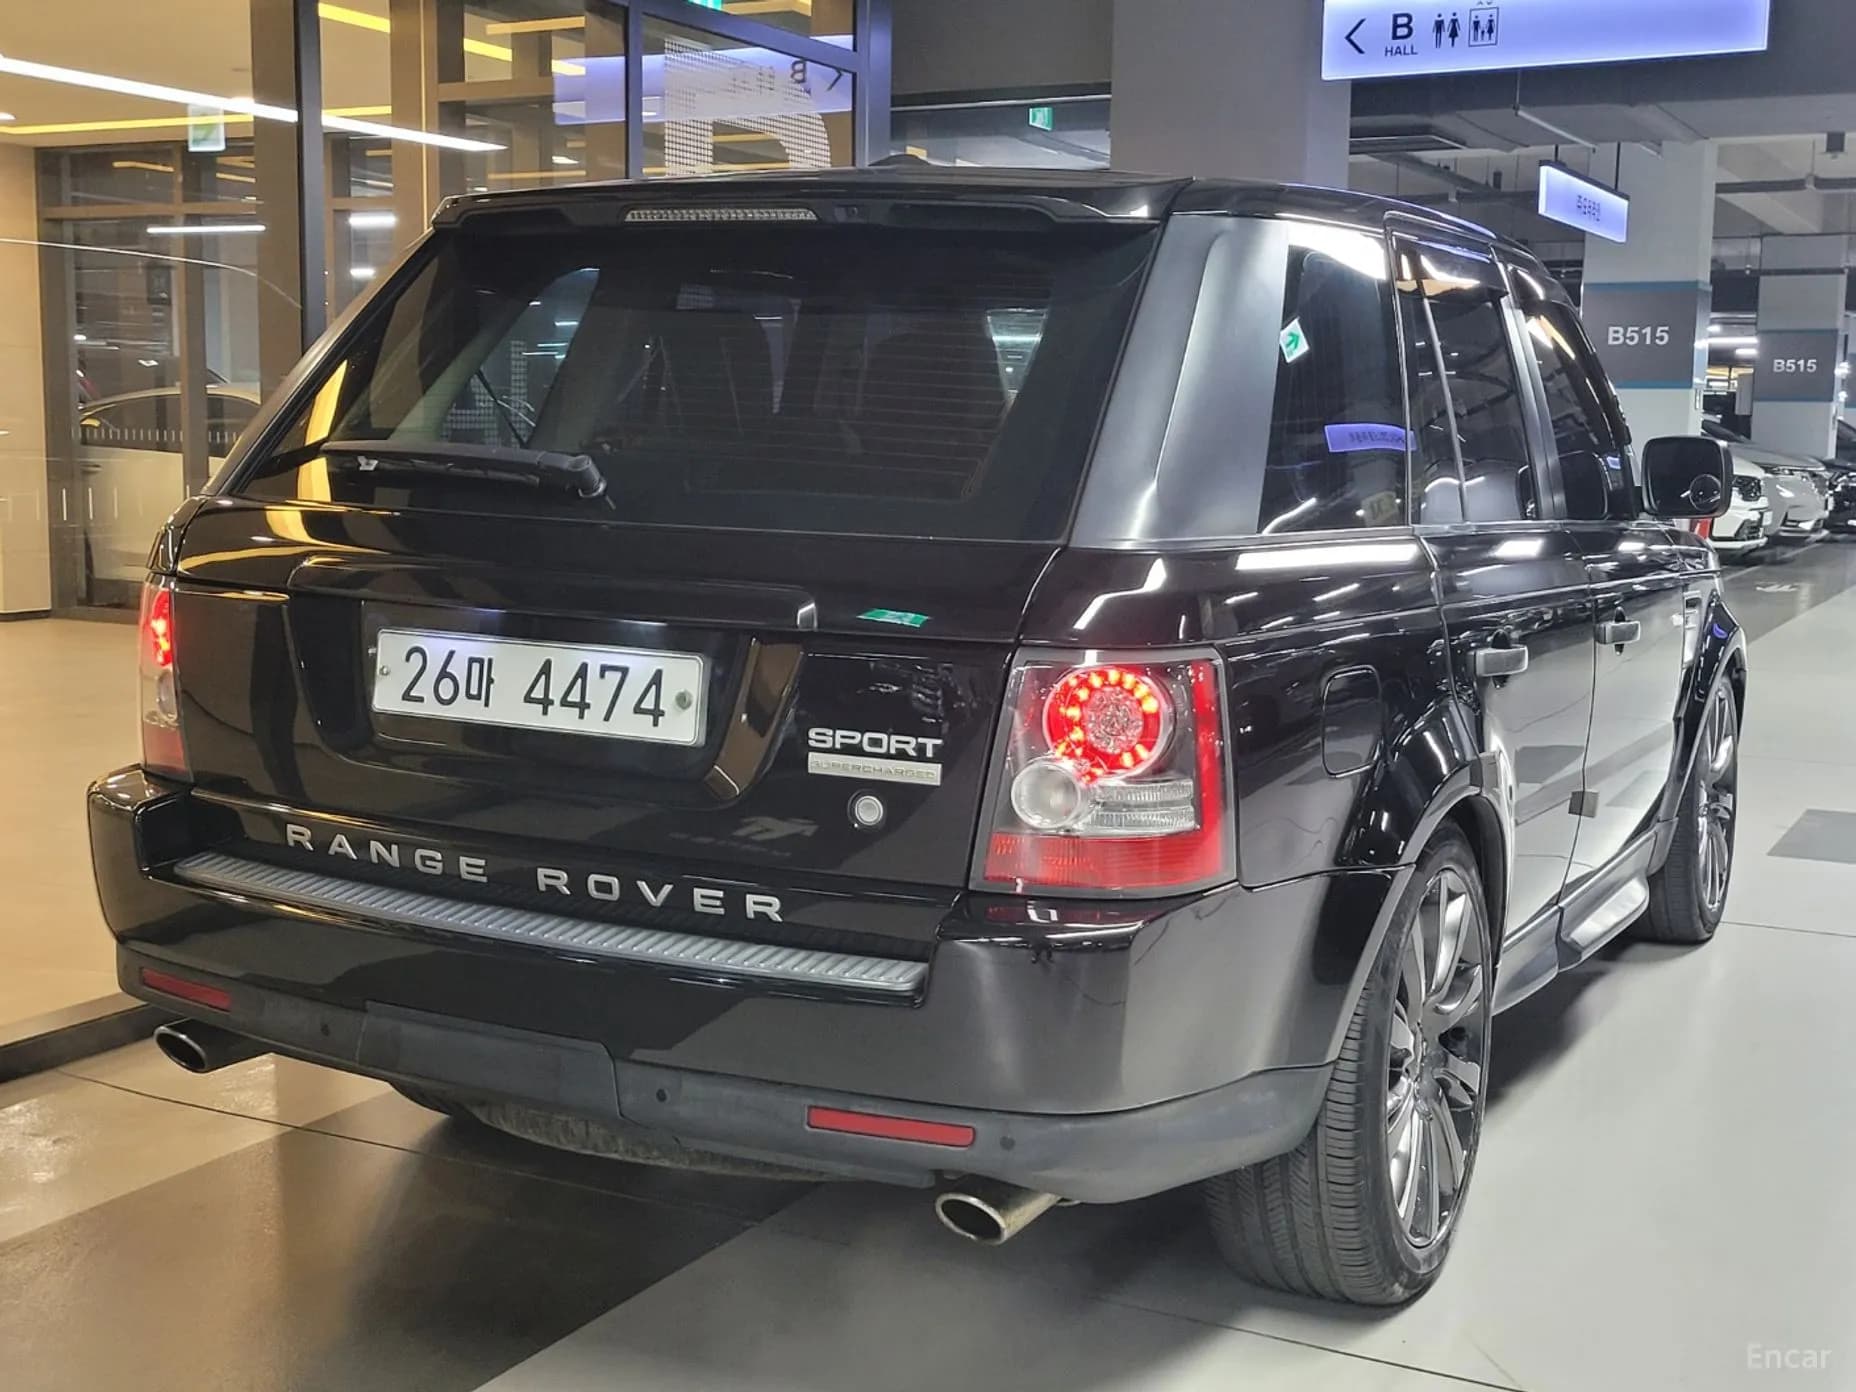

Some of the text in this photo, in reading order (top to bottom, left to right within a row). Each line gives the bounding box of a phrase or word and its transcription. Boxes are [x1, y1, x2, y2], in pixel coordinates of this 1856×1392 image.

[1392, 13, 1413, 40] B
[1385, 44, 1418, 57] HALL
[1607, 326, 1669, 346] B515
[1773, 359, 1817, 374] B515
[401, 645, 665, 727] 26마 4474
[808, 727, 943, 758] SPORT
[811, 760, 937, 780] SUPERCHARGED
[286, 823, 783, 922] RANGE ROVER
